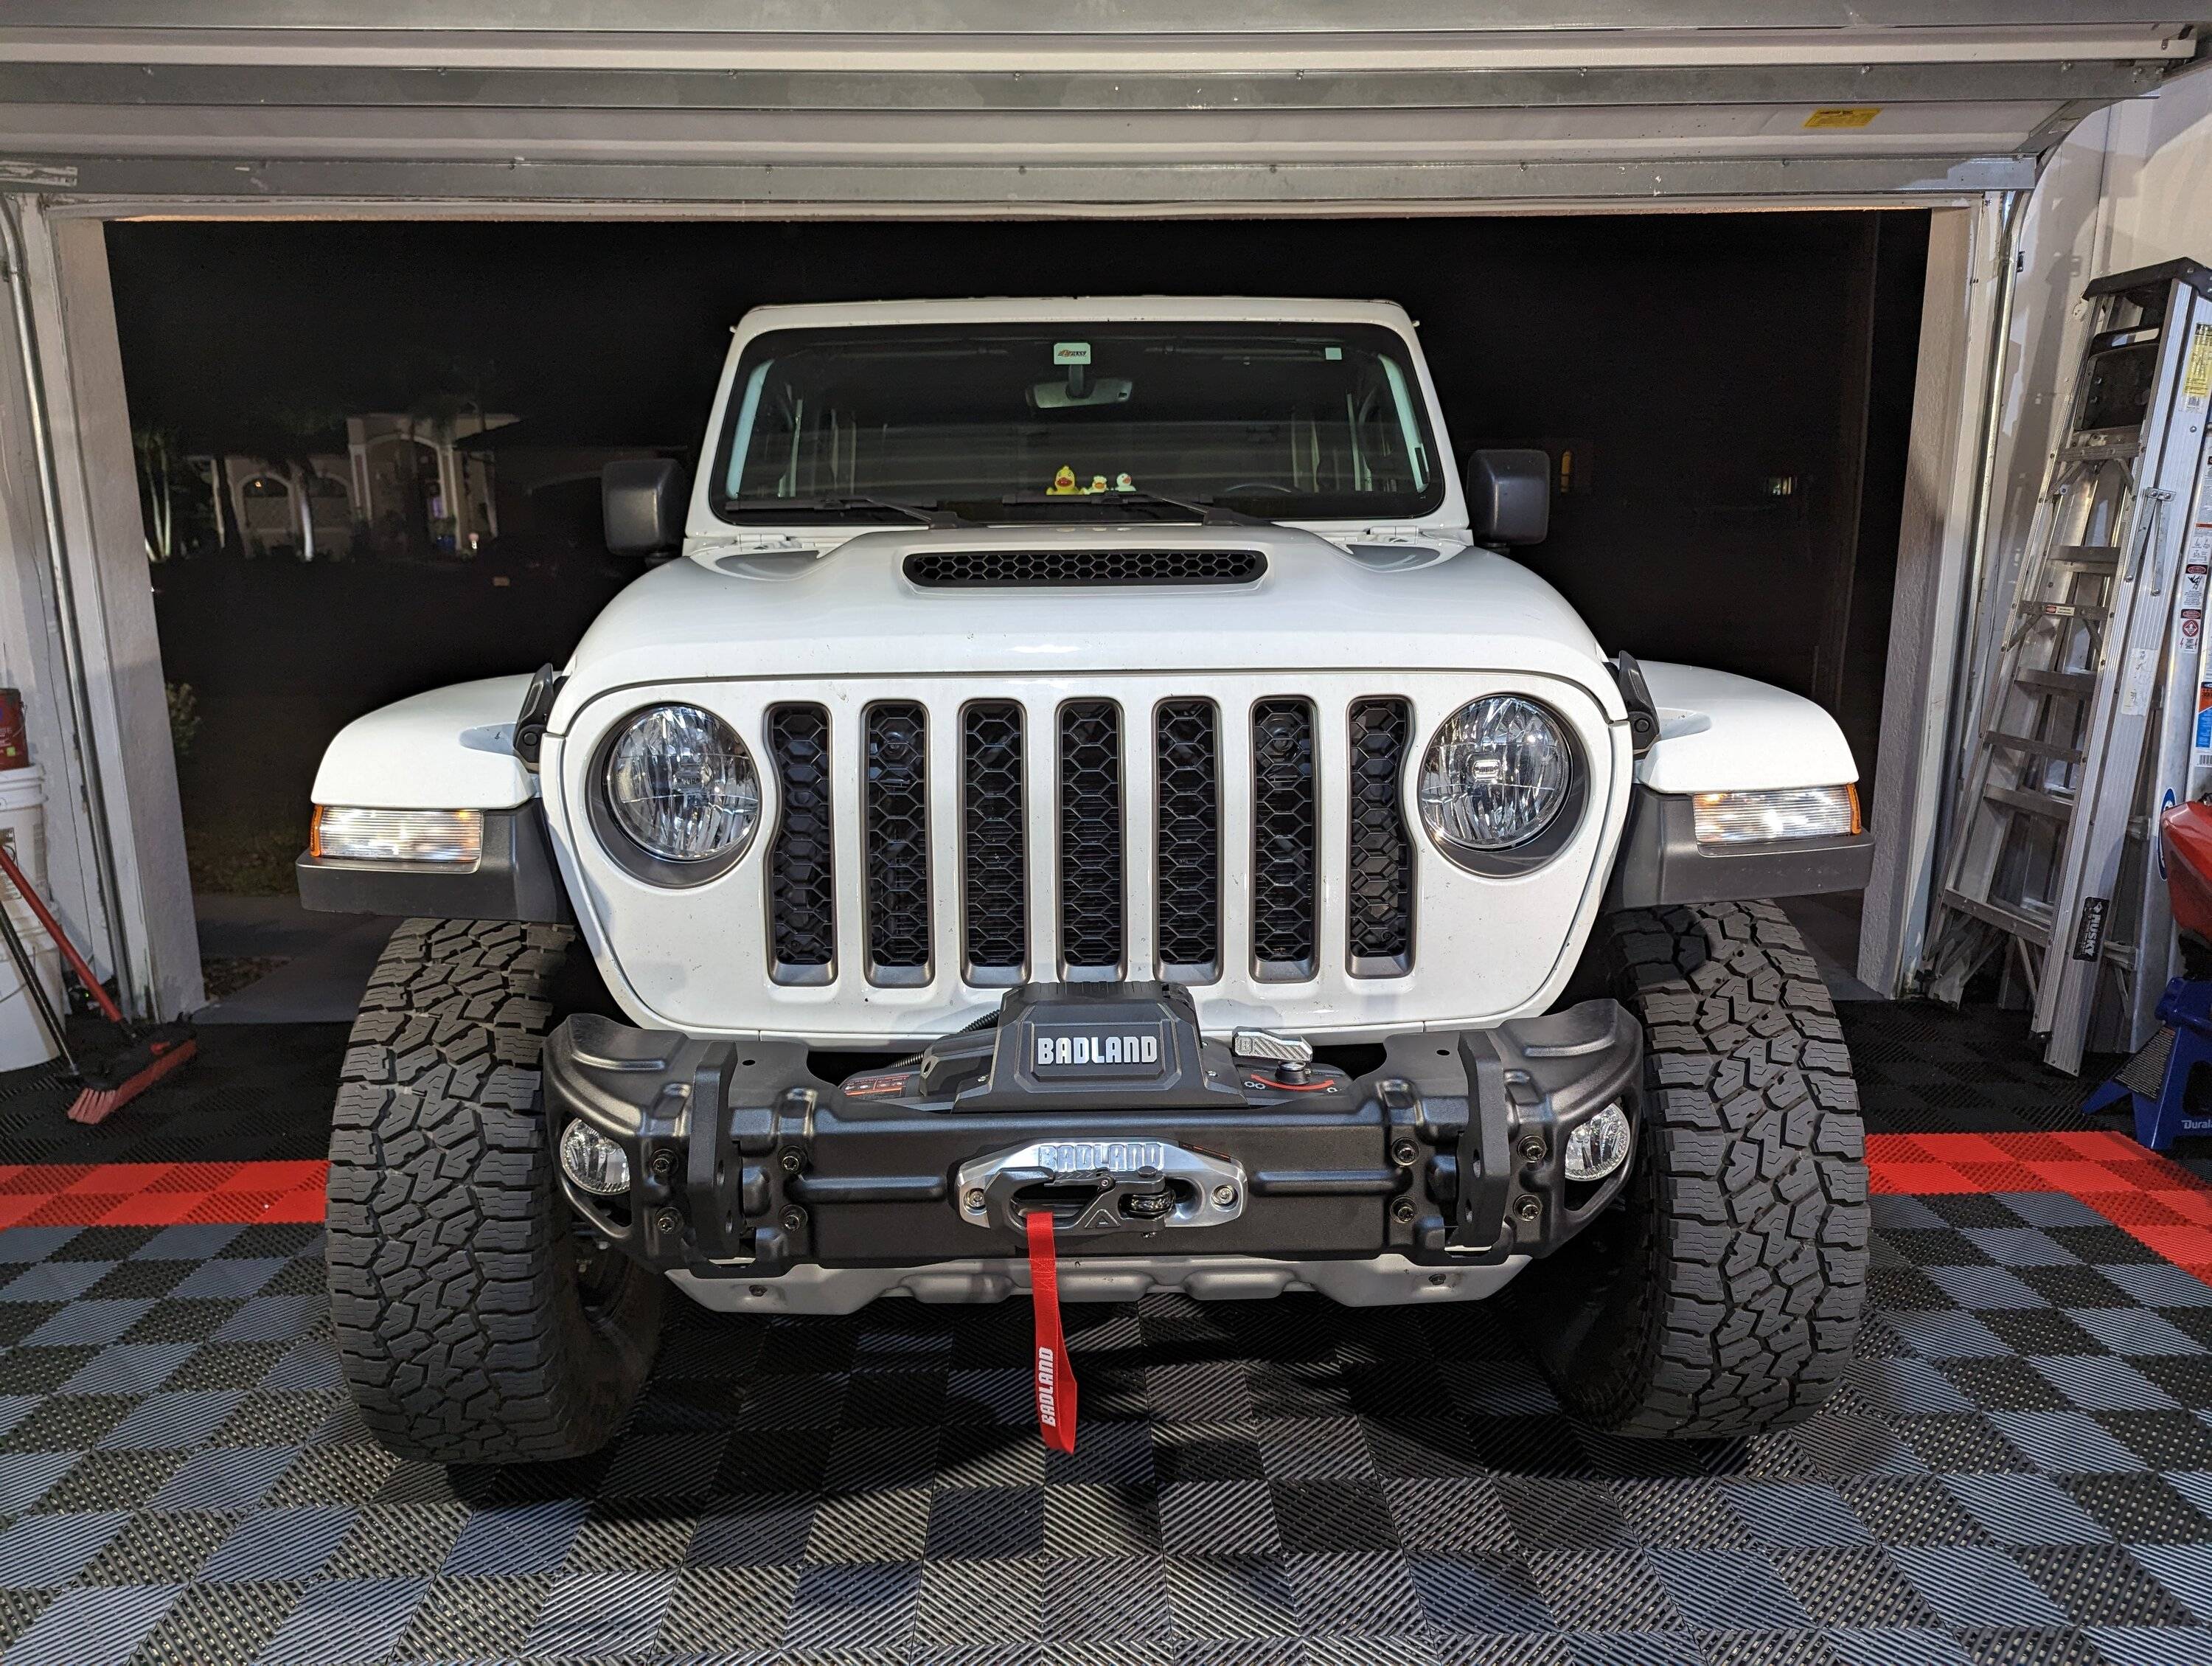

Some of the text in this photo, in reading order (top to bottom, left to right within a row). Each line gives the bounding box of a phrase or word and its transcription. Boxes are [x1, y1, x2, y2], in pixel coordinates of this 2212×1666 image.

[2084, 914, 2101, 957] HUSKY
[1037, 1036, 1158, 1064] BADLAND
[1038, 1143, 1164, 1172] BADLAND
[1038, 1346, 1056, 1427] BADLAND
